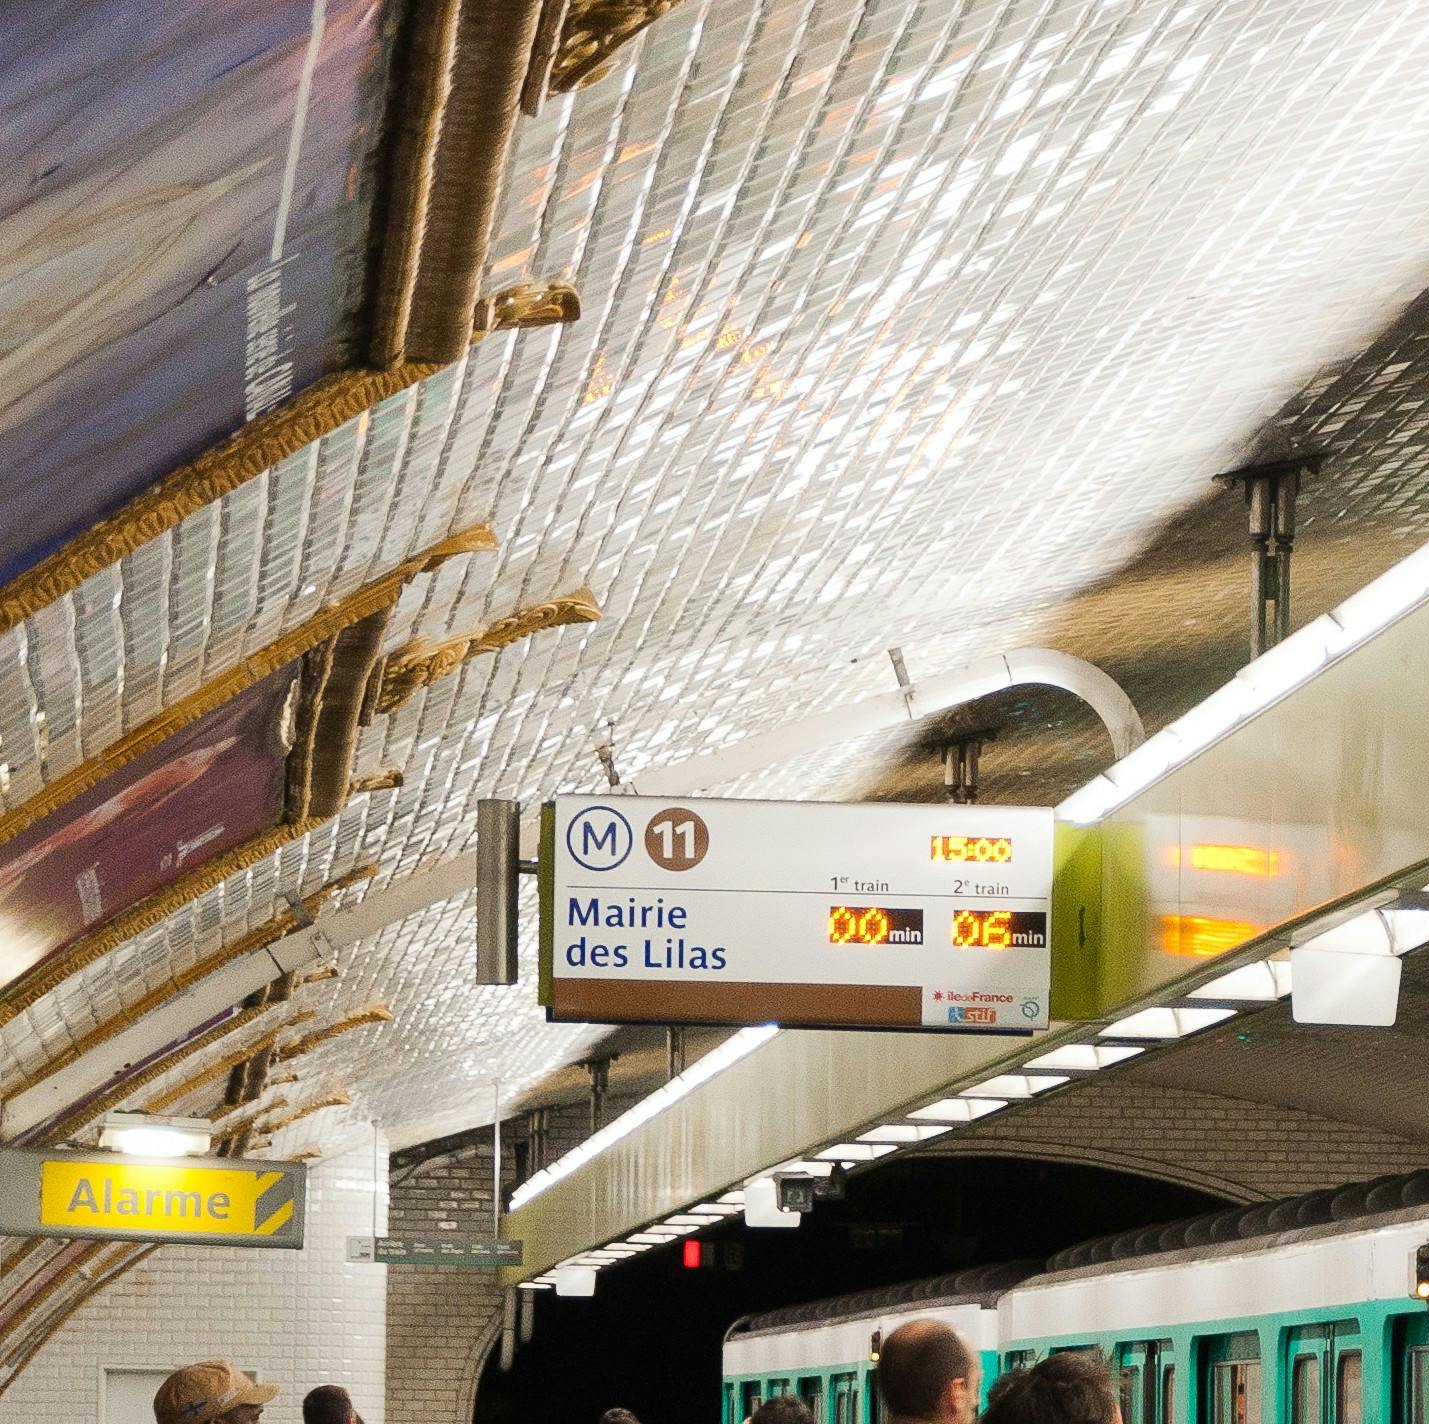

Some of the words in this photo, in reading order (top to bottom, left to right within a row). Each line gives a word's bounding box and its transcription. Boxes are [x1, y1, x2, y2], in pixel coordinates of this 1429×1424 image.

[582, 820, 617, 857] M
[652, 820, 696, 860] 11
[932, 836, 1012, 862] 15:00
[830, 876, 849, 892] 1er
[855, 880, 889, 892] train
[953, 879, 970, 894] 2e
[975, 882, 1009, 895] train
[568, 897, 688, 929] Mairie
[829, 907, 888, 944] 00
[889, 927, 922, 943] min
[952, 910, 1011, 949] 06
[1012, 931, 1044, 945] min
[565, 936, 629, 968] des
[644, 938, 727, 970] Lilas
[67, 1178, 231, 1219] Alarme
